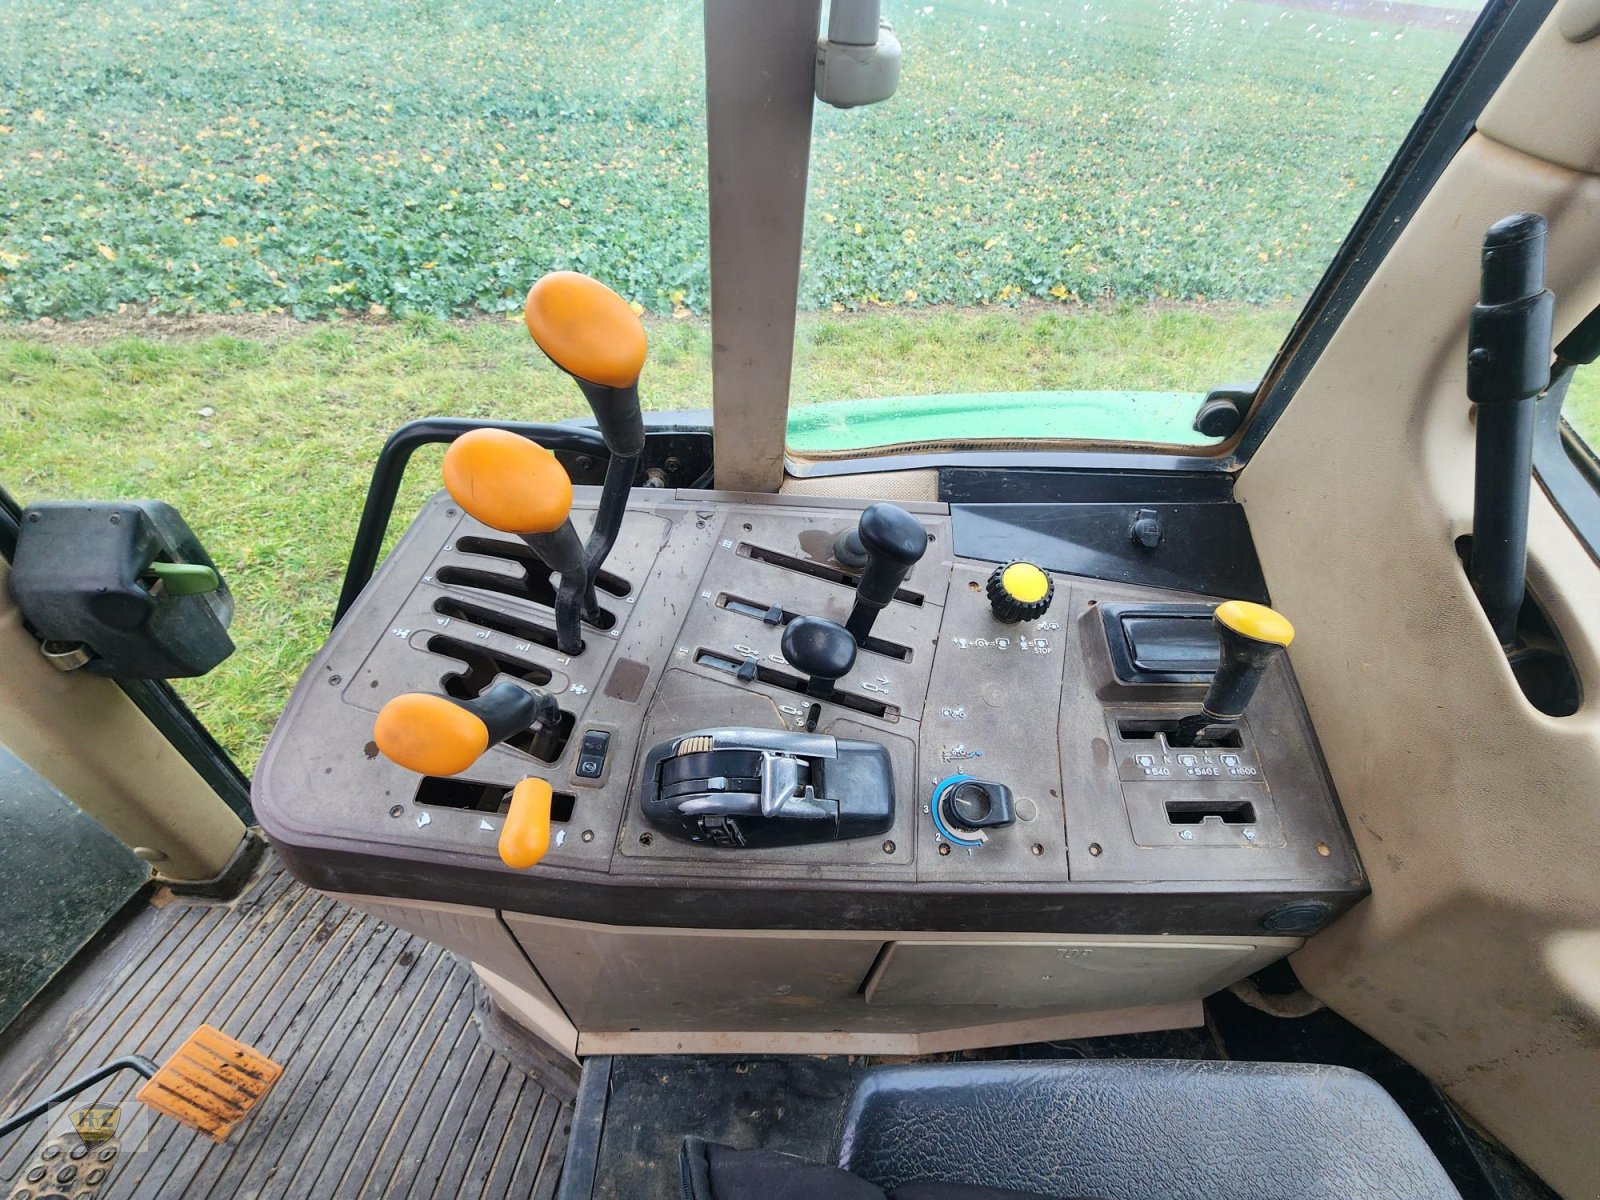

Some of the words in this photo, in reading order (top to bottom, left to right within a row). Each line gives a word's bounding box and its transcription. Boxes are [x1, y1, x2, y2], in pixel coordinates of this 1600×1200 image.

[1151, 768, 1170, 776] 540
[923, 804, 930, 813] 3
[935, 833, 942, 842] 2
[967, 848, 973, 856] 1
